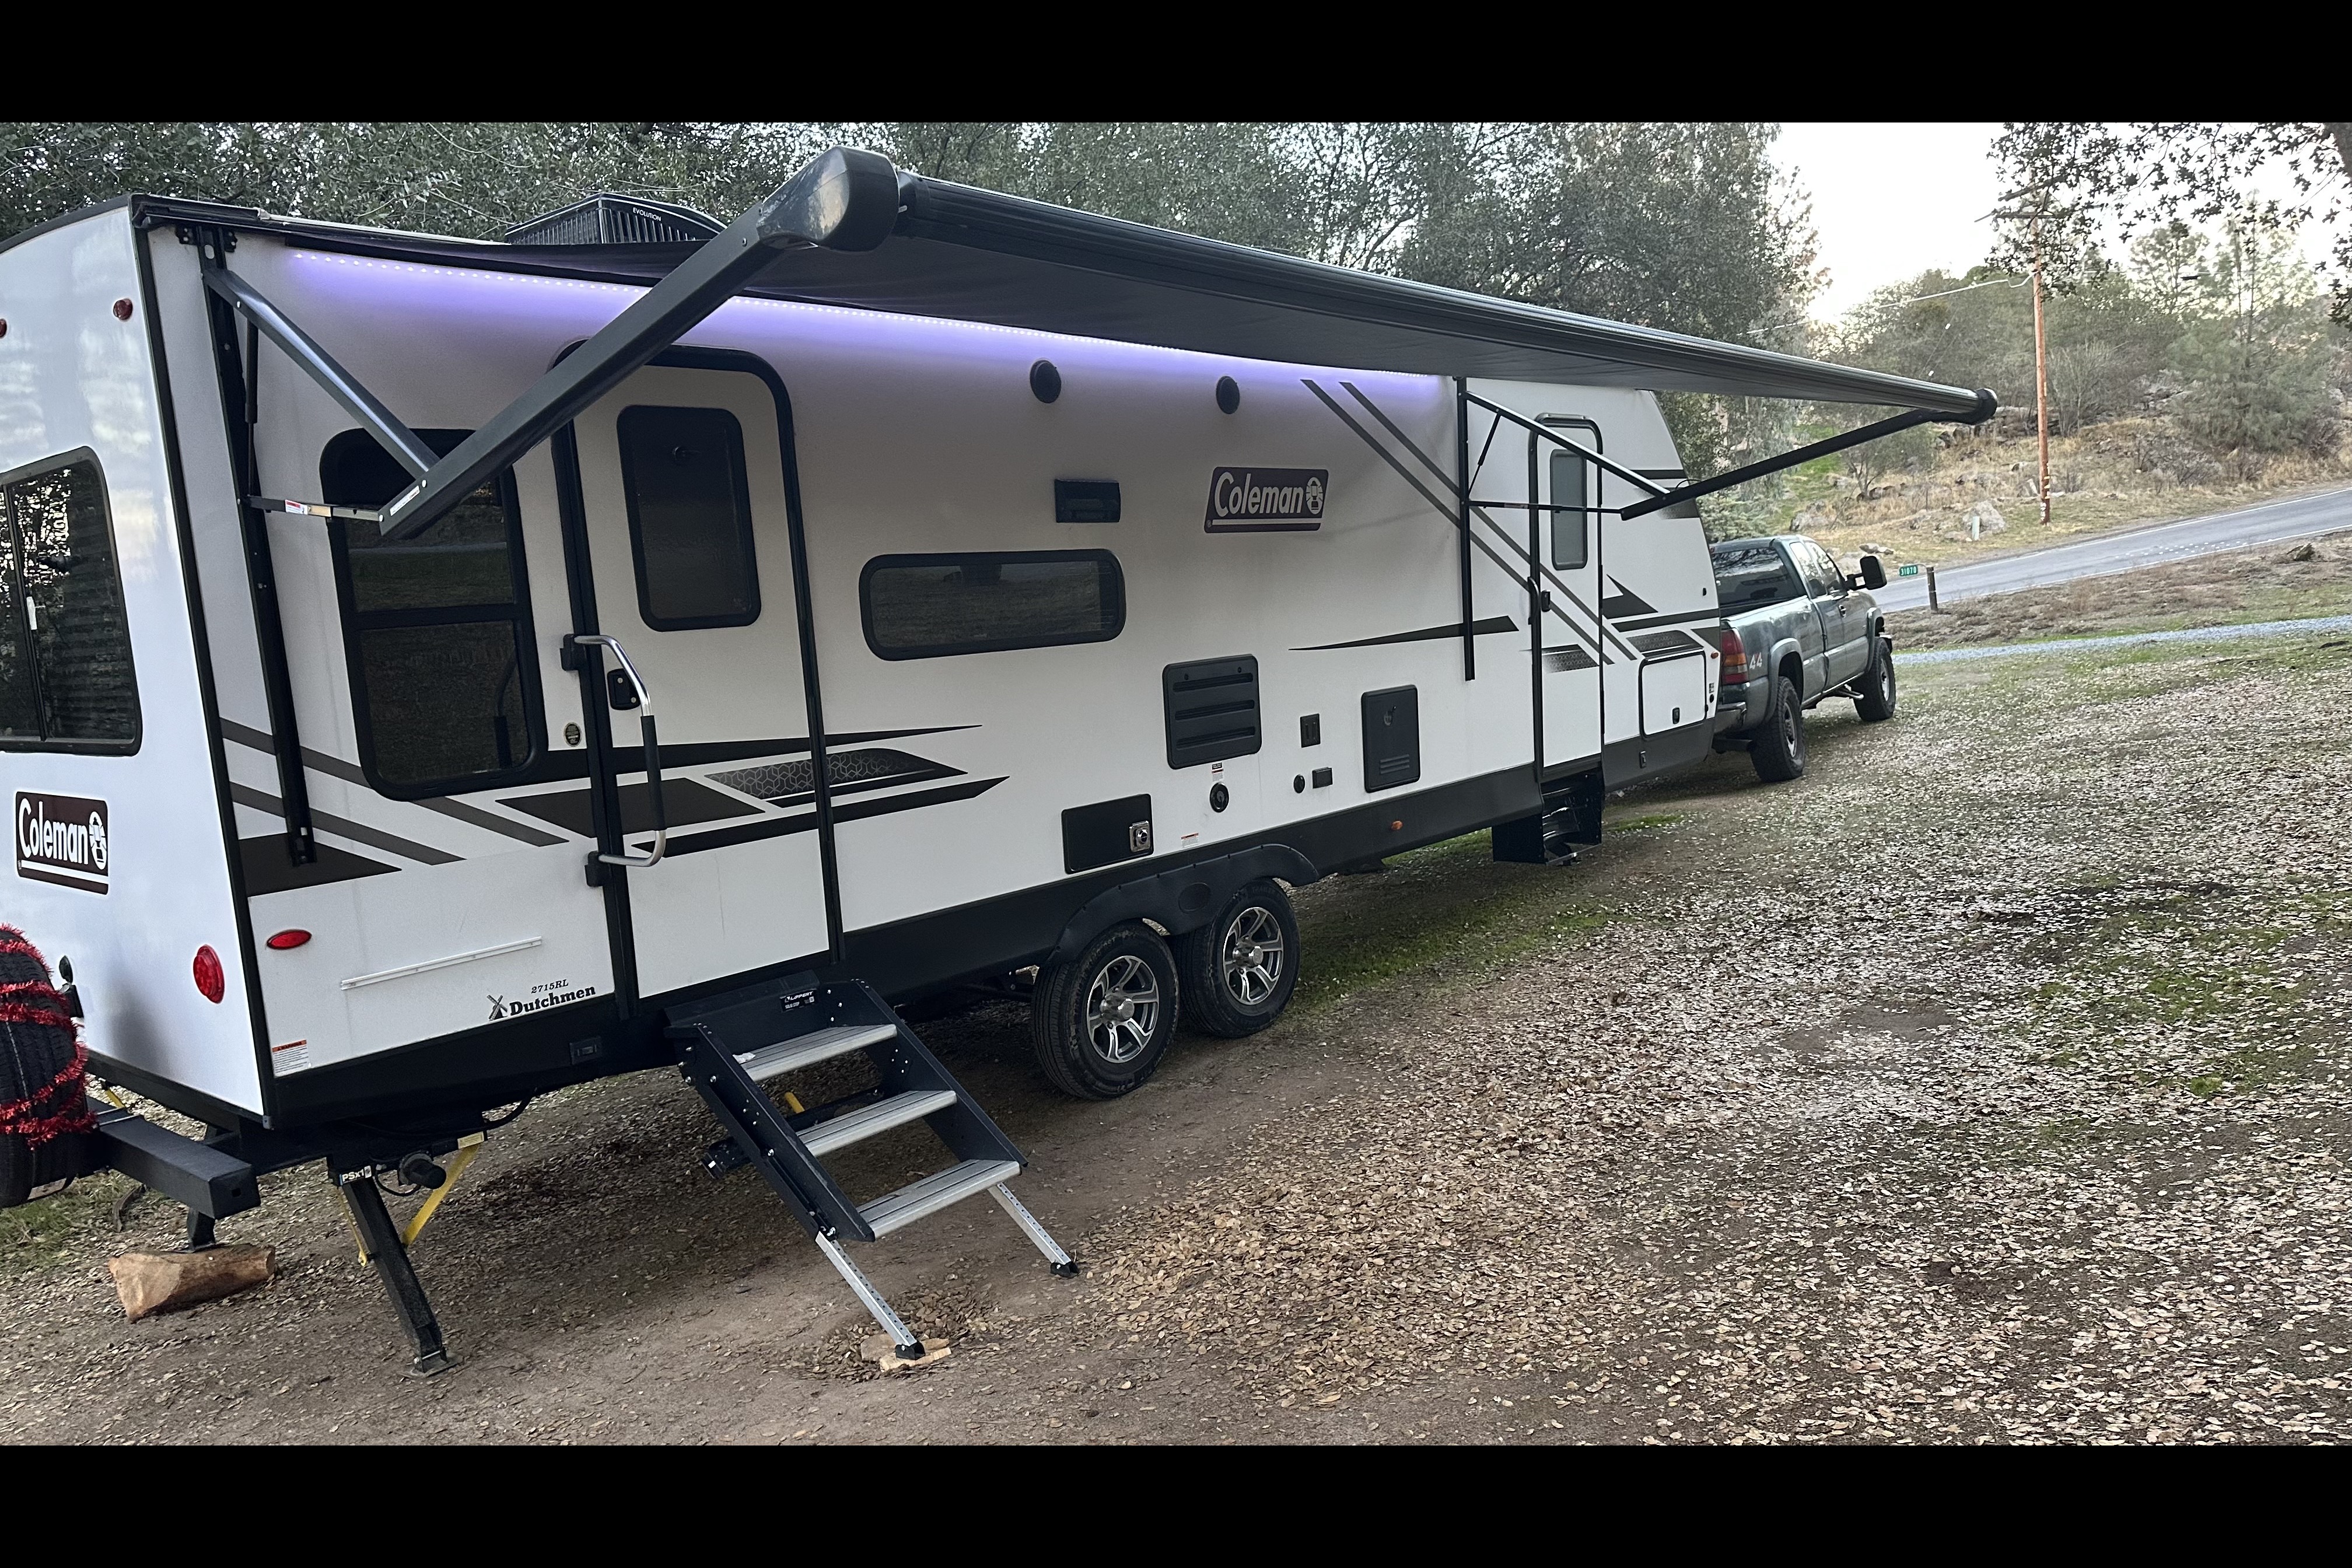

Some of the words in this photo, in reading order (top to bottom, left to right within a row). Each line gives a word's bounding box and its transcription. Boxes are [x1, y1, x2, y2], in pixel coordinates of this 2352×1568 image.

[633, 207, 661, 221] EVOLUTION
[1214, 471, 1304, 517] Coleman
[1901, 566, 1917, 576] 31070
[19, 798, 88, 865] Coleman
[531, 979, 569, 994] 2715RL
[509, 986, 596, 1016] Dutchmen
[342, 1168, 365, 1182] PSx1
